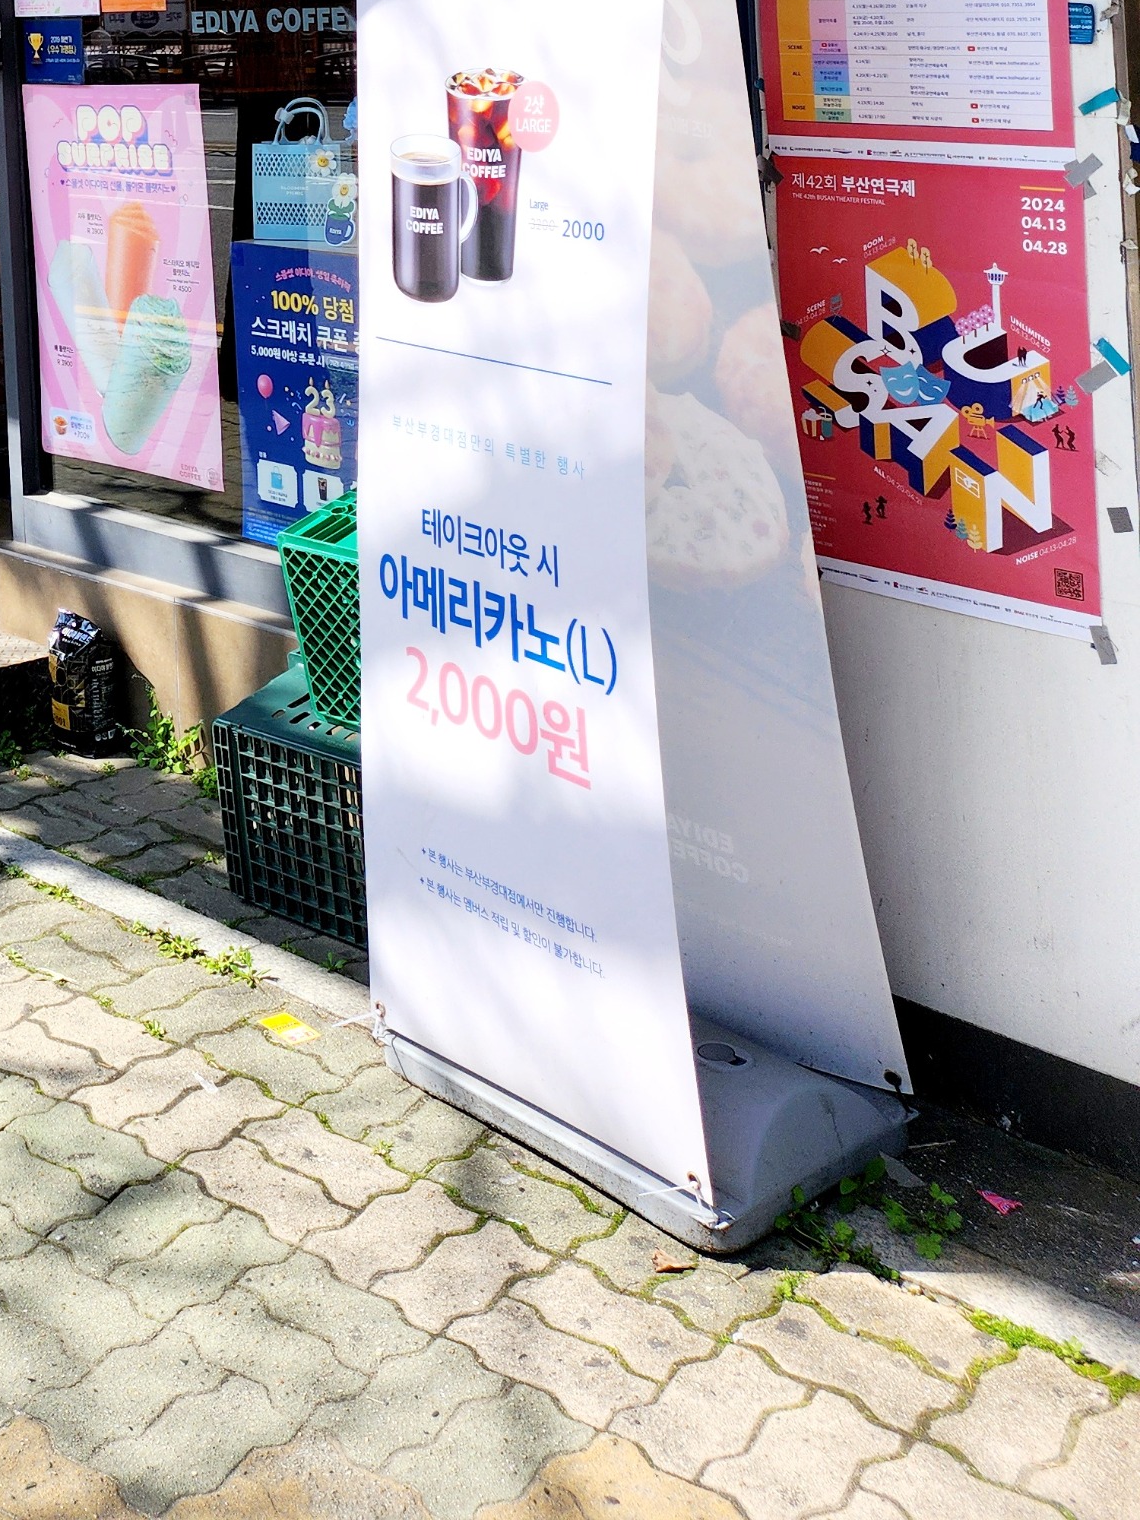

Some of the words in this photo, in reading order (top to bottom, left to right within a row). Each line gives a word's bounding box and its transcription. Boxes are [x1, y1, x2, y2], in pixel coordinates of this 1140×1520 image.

[191, 9, 259, 34] EDIYA
[524, 94, 545, 116] 2샷
[76, 104, 149, 144] POP
[515, 118, 552, 134] LARGE
[57, 140, 173, 177] SURPRISE
[466, 147, 502, 163] EDIYA
[462, 164, 506, 179] COFFEE
[791, 173, 837, 192] 제42회
[841, 175, 916, 198] 부산연극제
[529, 198, 549, 212] Large
[816, 194, 835, 202] BUSAN
[836, 195, 859, 204] THEATER
[860, 197, 886, 206] FESTIVAL
[1021, 196, 1066, 213] 2024
[409, 205, 439, 221] EDIYA
[1021, 216, 1067, 232] 04.13
[405, 221, 444, 235] COFFEE
[562, 218, 605, 242] 2000
[862, 235, 884, 251] BOOM
[1022, 240, 1068, 255] 04.28
[178, 285, 192, 293] 4500
[270, 290, 319, 316] 100%
[323, 296, 355, 324] 당첨
[806, 299, 826, 314] SCENE
[251, 316, 312, 348] 스크래치
[317, 325, 349, 353] 쿠폰
[1010, 315, 1051, 347] UNLIMITED
[250, 344, 282, 360] 5,000원
[282, 348, 298, 363] 이상
[299, 351, 315, 367] 주문
[316, 355, 325, 368] 시
[392, 413, 495, 457] 부산부경대점만의
[505, 442, 546, 470] 특별한
[557, 455, 585, 480] 행사
[873, 465, 887, 480] ALL
[421, 508, 530, 577] 테이크아웃
[537, 545, 559, 588] 시
[1015, 550, 1039, 566] NOISE
[379, 553, 617, 696] 아메리카노(L)
[405, 646, 592, 790] 2,000원
[428, 848, 436, 864] 본
[438, 852, 463, 878] 행사는
[464, 866, 544, 918] 부산부경대점에서만
[546, 907, 598, 943] 진행합니다.
[426, 877, 435, 893] 본
[436, 882, 462, 908] 행사는
[463, 896, 490, 921] 멤버스
[491, 910, 509, 933] 적립
[511, 921, 520, 939] 및
[523, 926, 551, 954] 할인이
[553, 941, 606, 979] 불가합니다.
